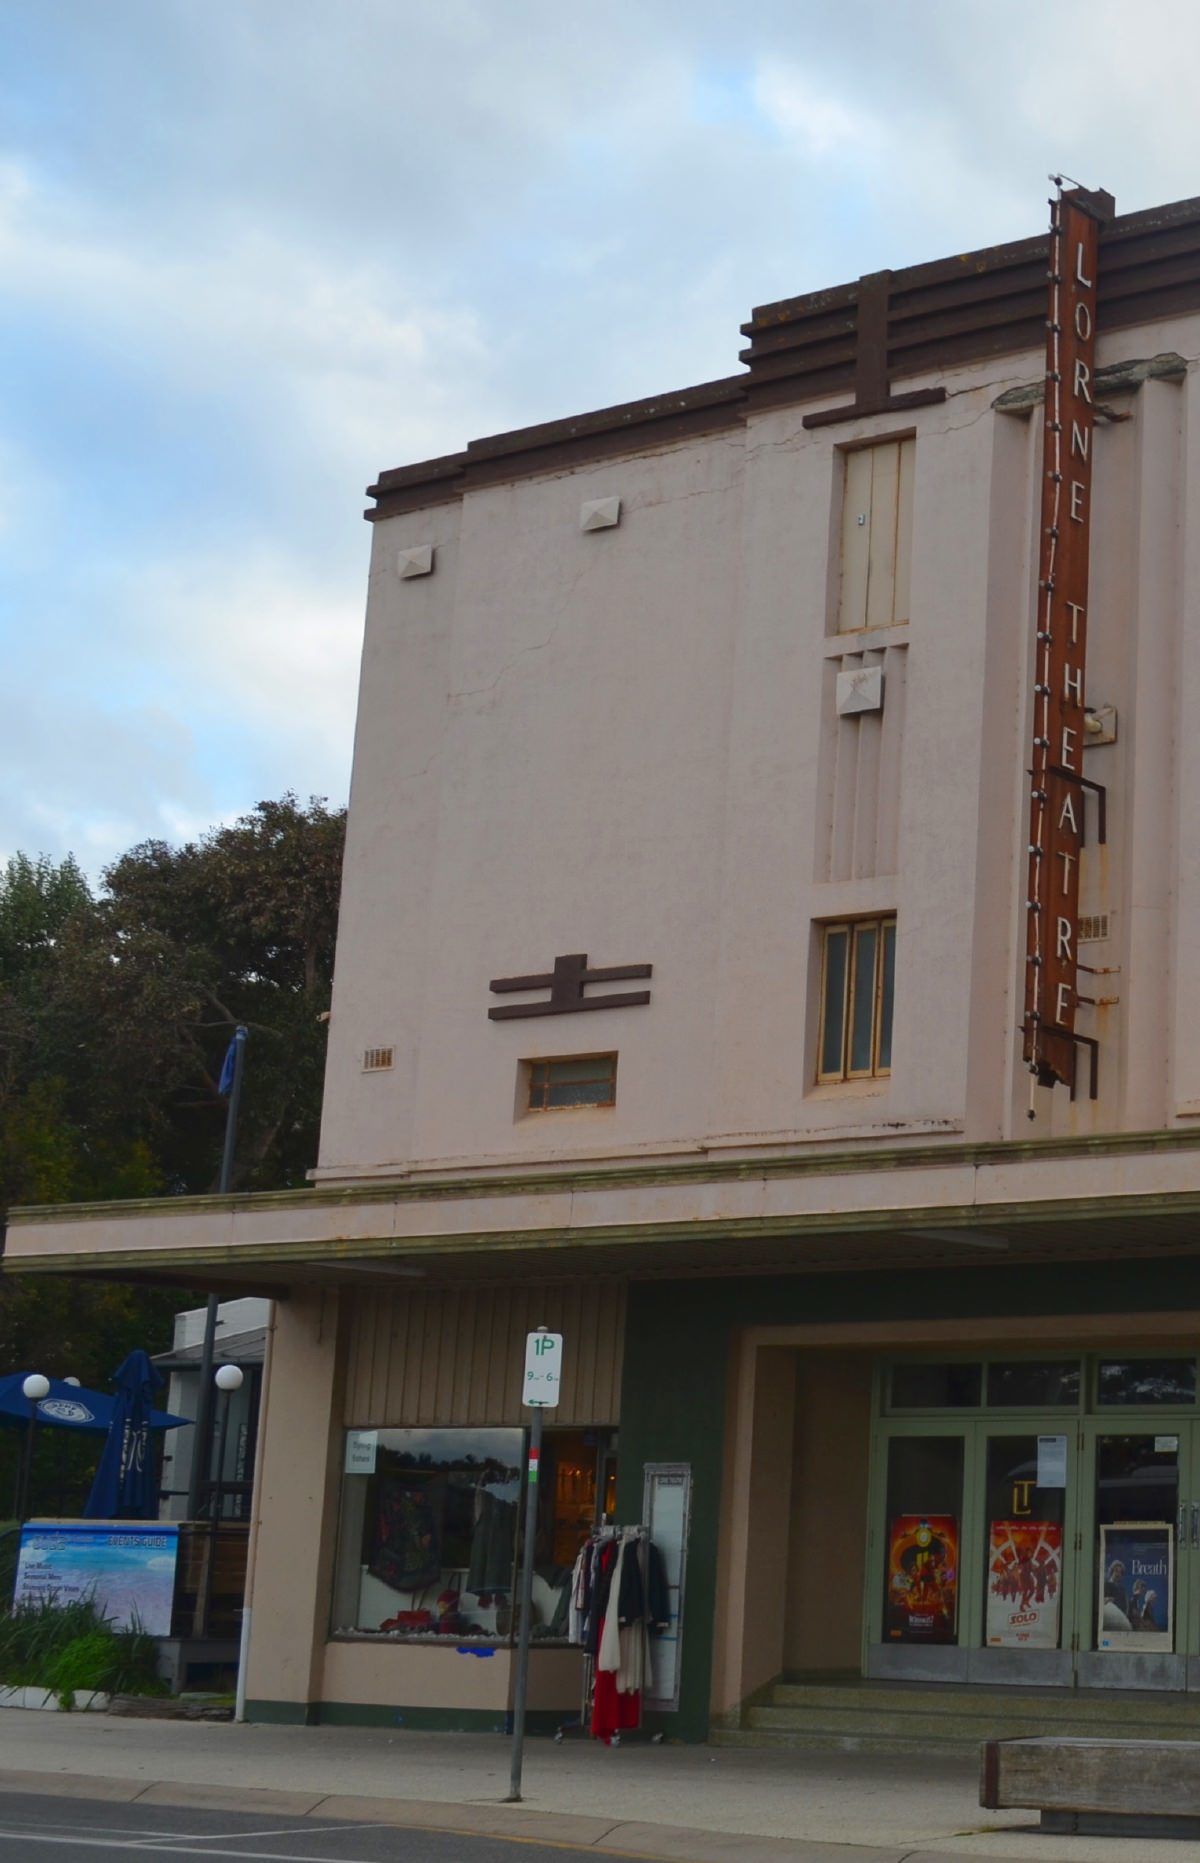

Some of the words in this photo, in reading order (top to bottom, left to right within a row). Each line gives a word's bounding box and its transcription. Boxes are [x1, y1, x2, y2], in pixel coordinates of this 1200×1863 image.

[1070, 242, 1092, 524] LORNE
[1055, 600, 1085, 1026] THEATRE
[534, 1338, 555, 1356] 1P
[108, 1535, 140, 1547] EVENTS
[142, 1536, 168, 1548] GUIDE
[1132, 1559, 1167, 1576] Breath
[1009, 1612, 1037, 1625] SOLO
